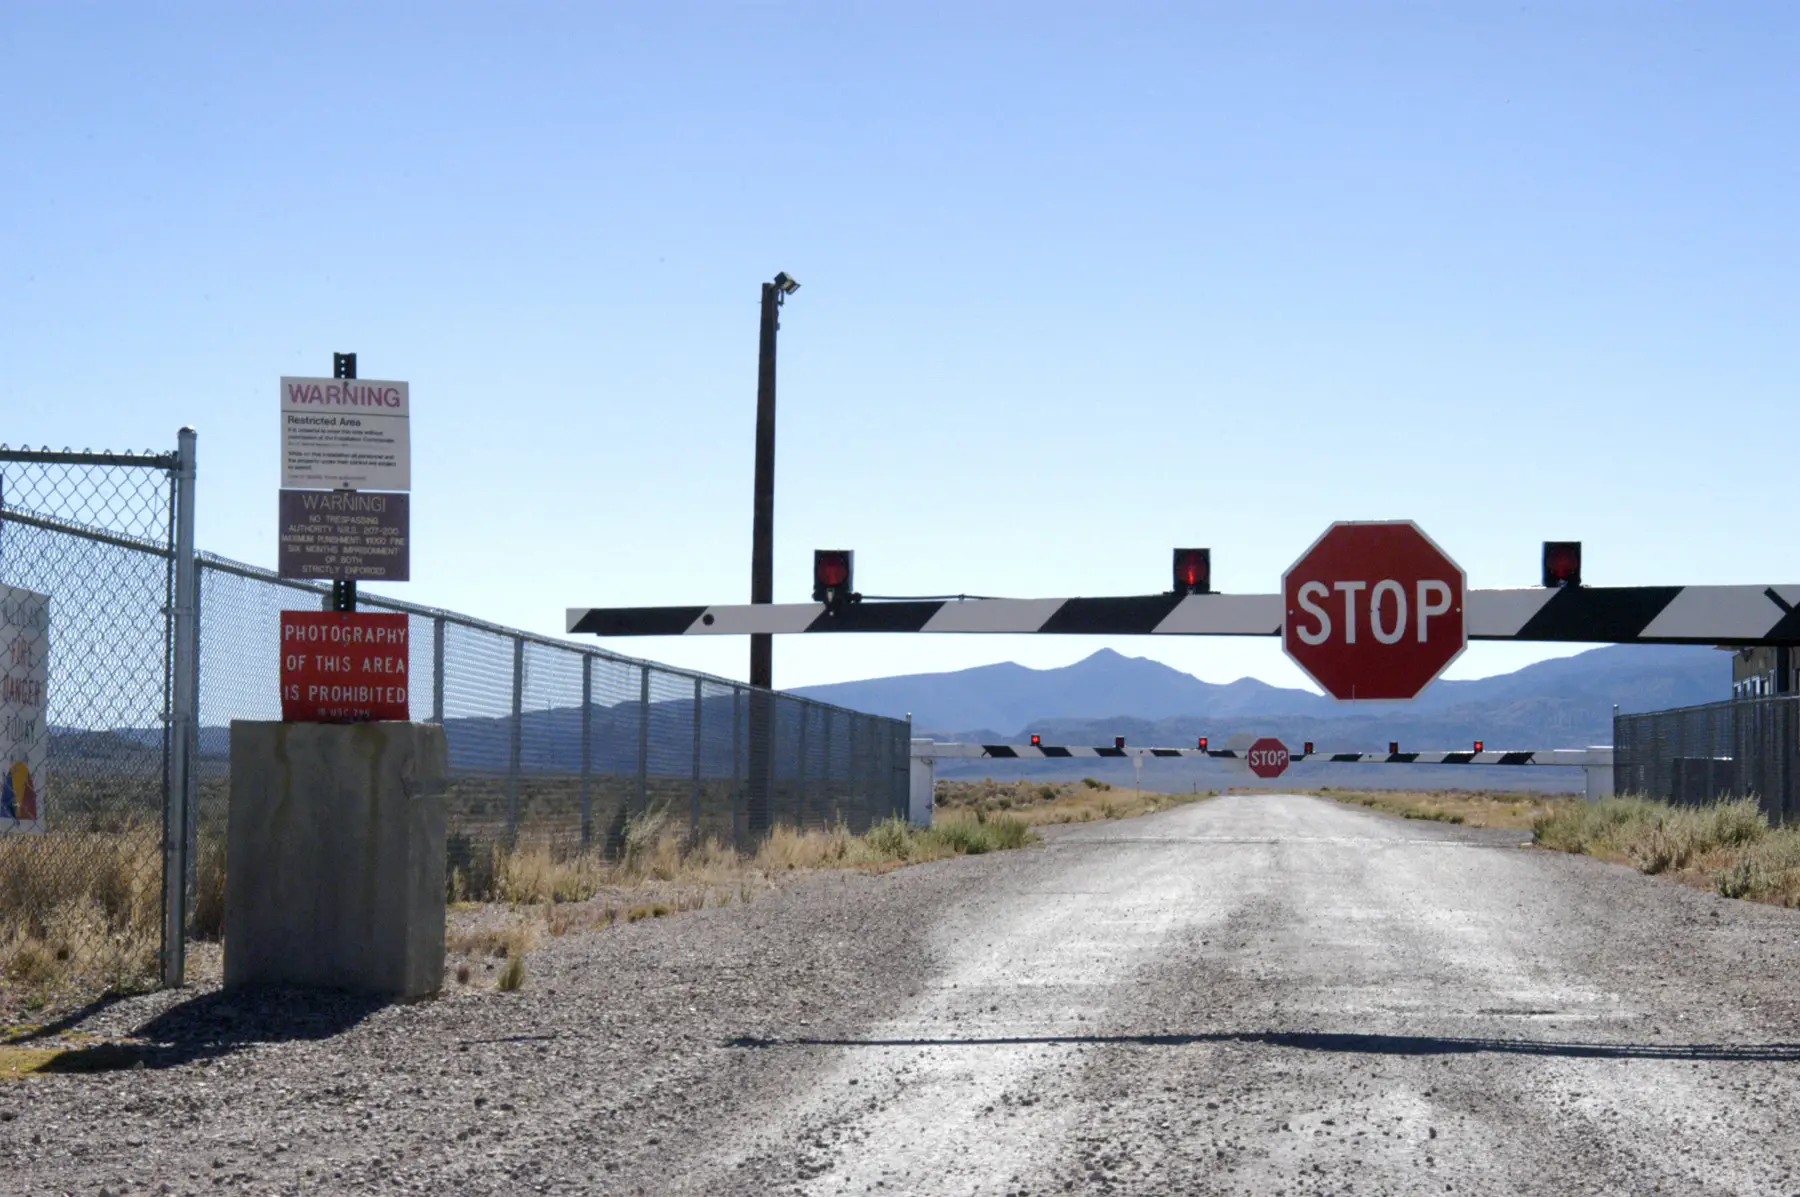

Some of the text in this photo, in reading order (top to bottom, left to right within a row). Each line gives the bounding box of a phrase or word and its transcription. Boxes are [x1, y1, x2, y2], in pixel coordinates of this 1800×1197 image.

[288, 384, 400, 407] WARNING
[288, 415, 361, 427] Restricted Area
[309, 515, 379, 525] NO TRESPASSING
[288, 525, 333, 534] AUTHORITY
[287, 545, 301, 553] SIX
[325, 556, 363, 565] OR BOTH
[302, 565, 386, 576] STRICTLY ENFORCED
[1296, 579, 1452, 645] STOP
[284, 624, 407, 644] PHOTOGRAPHY
[286, 654, 406, 674] OF THIS AREA
[3, 675, 41, 707] DANGER
[284, 684, 407, 704] IS PROHIBITED
[6, 714, 36, 744] TODAY
[1250, 750, 1287, 766] STOP
